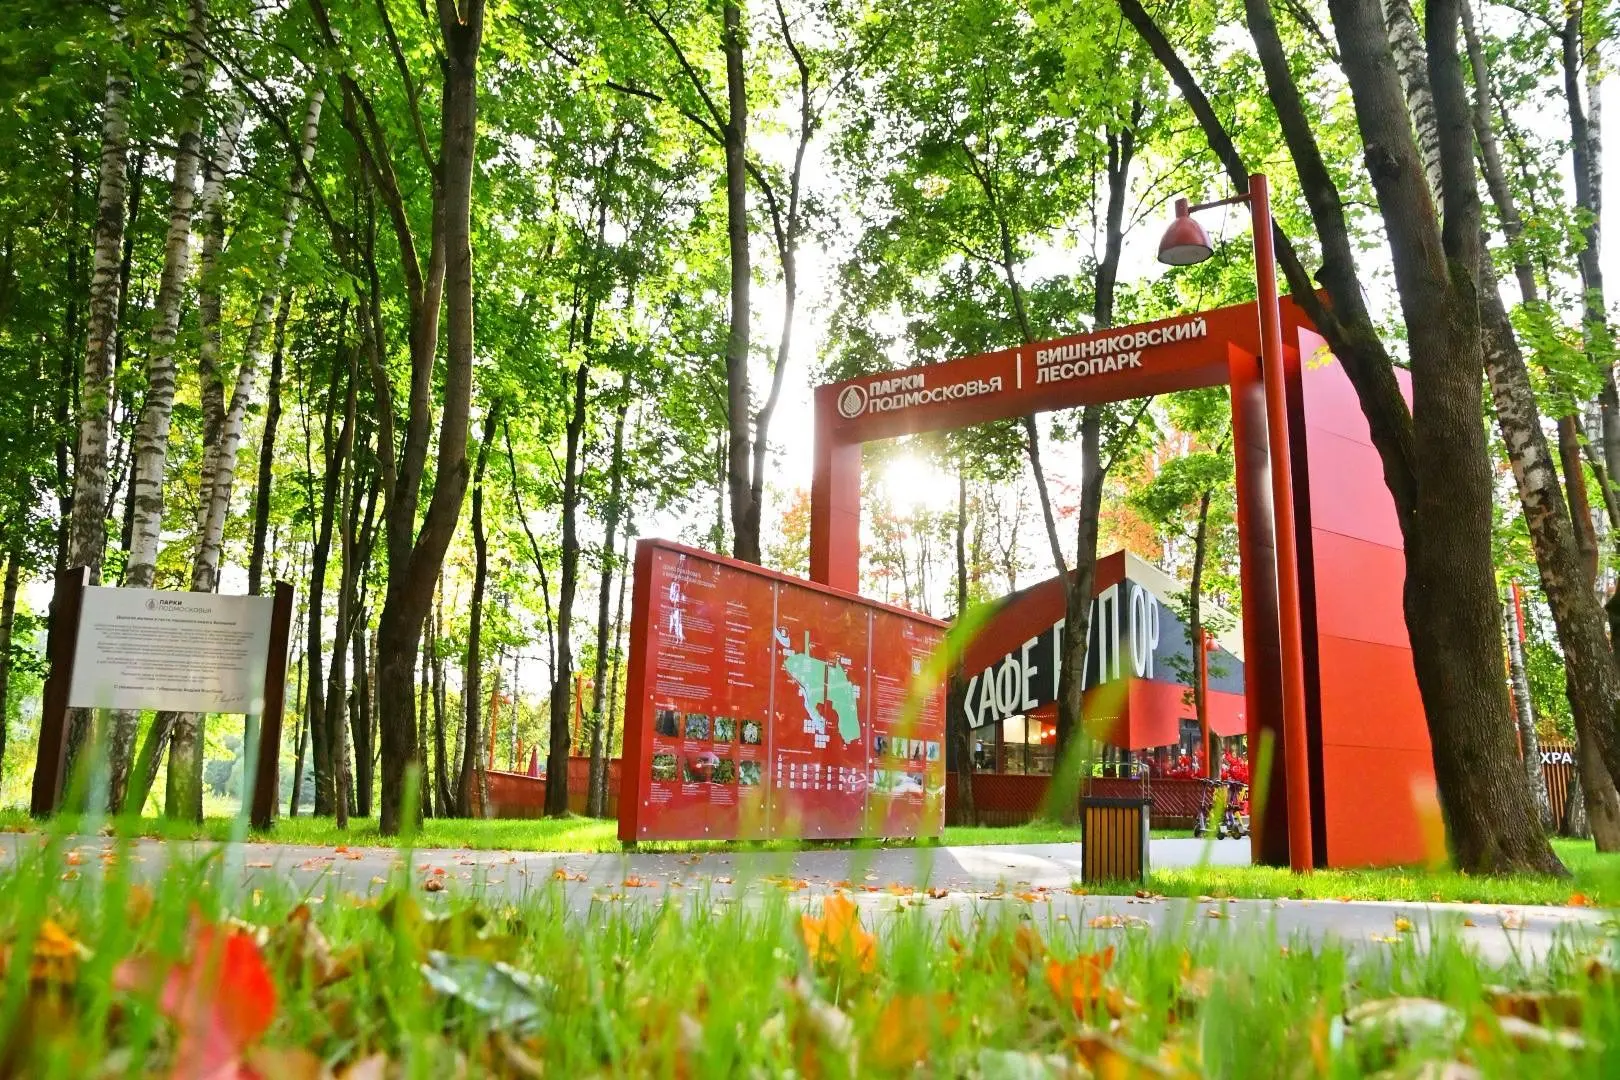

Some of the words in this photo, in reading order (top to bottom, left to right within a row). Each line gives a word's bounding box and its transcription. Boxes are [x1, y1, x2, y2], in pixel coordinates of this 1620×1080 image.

[1036, 317, 1207, 366] ВИШНЯКОВСКИЙ
[1036, 350, 1143, 385] ЛЕСОПАРК
[868, 375, 1003, 413] ПОДМОСКОВЬЯ
[869, 373, 926, 397] ПАРКИ
[158, 605, 212, 614] ПОДМОСКОВЬЯ
[1540, 751, 1573, 765] ХРА
